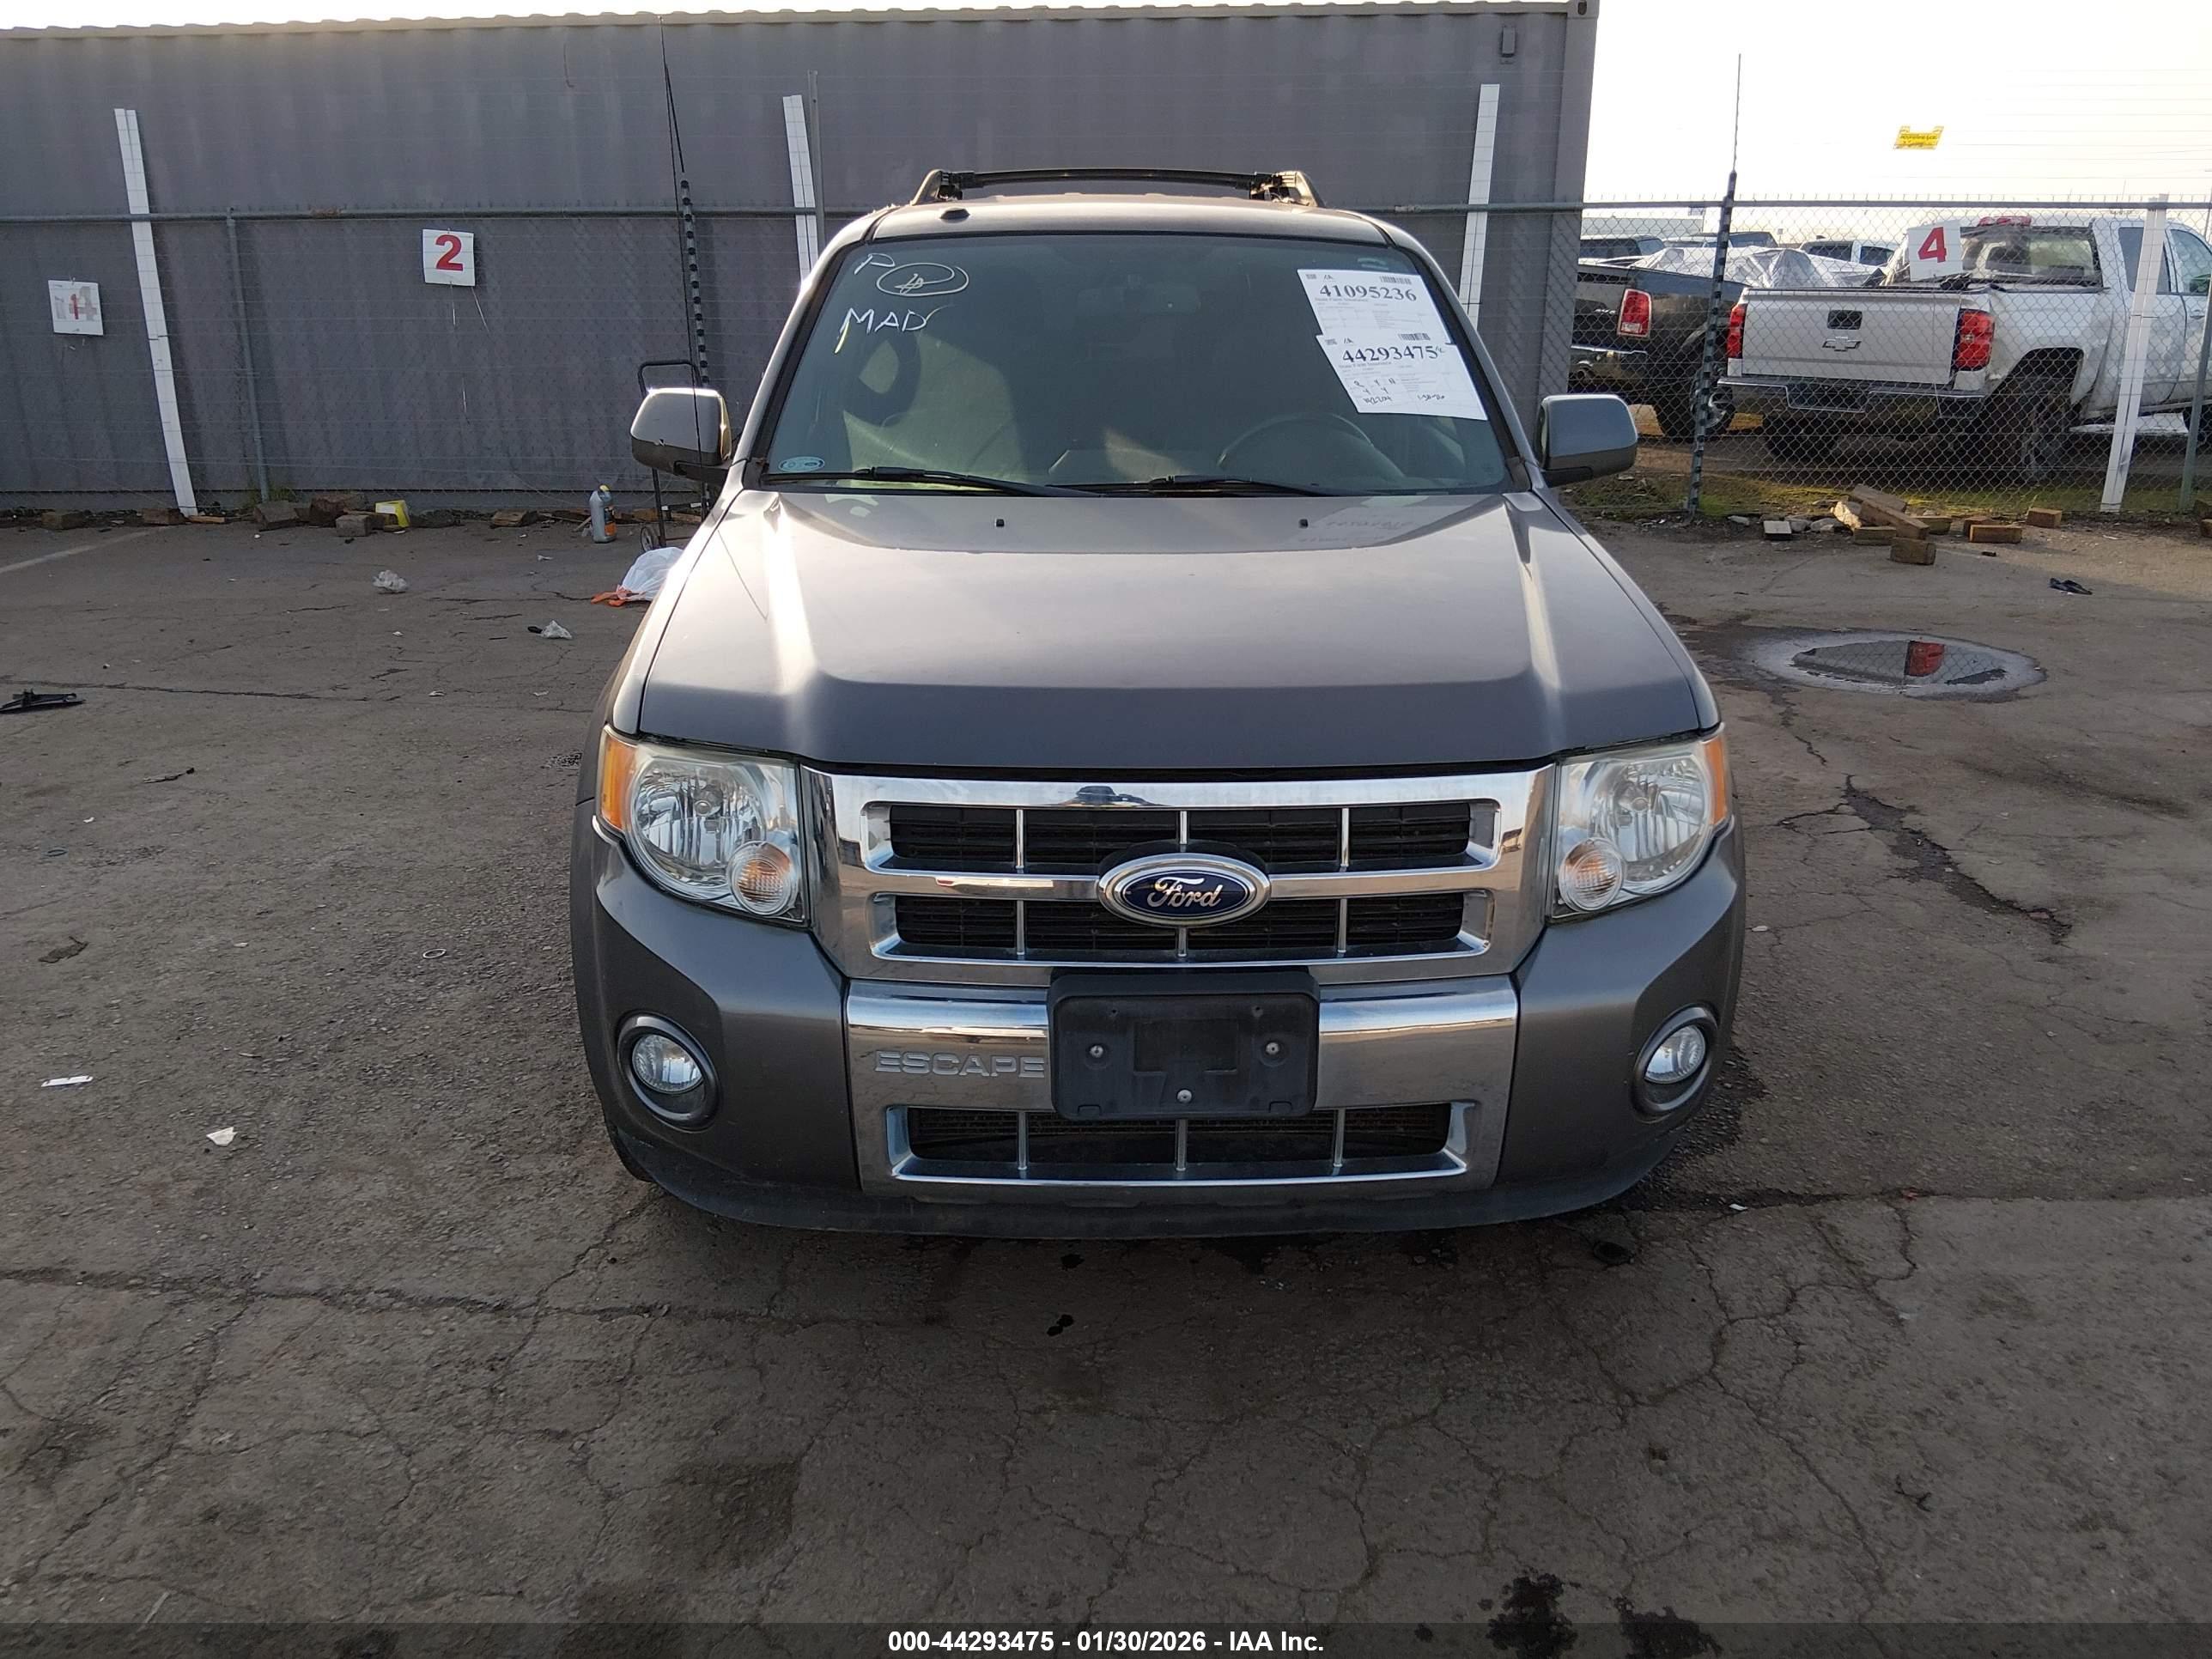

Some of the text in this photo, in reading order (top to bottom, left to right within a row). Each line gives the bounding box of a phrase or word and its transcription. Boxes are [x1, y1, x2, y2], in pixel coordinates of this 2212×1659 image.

[435, 234, 464, 271] 2
[1917, 226, 1948, 264] 4
[1319, 284, 1417, 301] 41095236
[1342, 345, 1438, 362] 44293475
[1146, 876, 1224, 908] Ford
[874, 1050, 1045, 1079] ESCAPE
